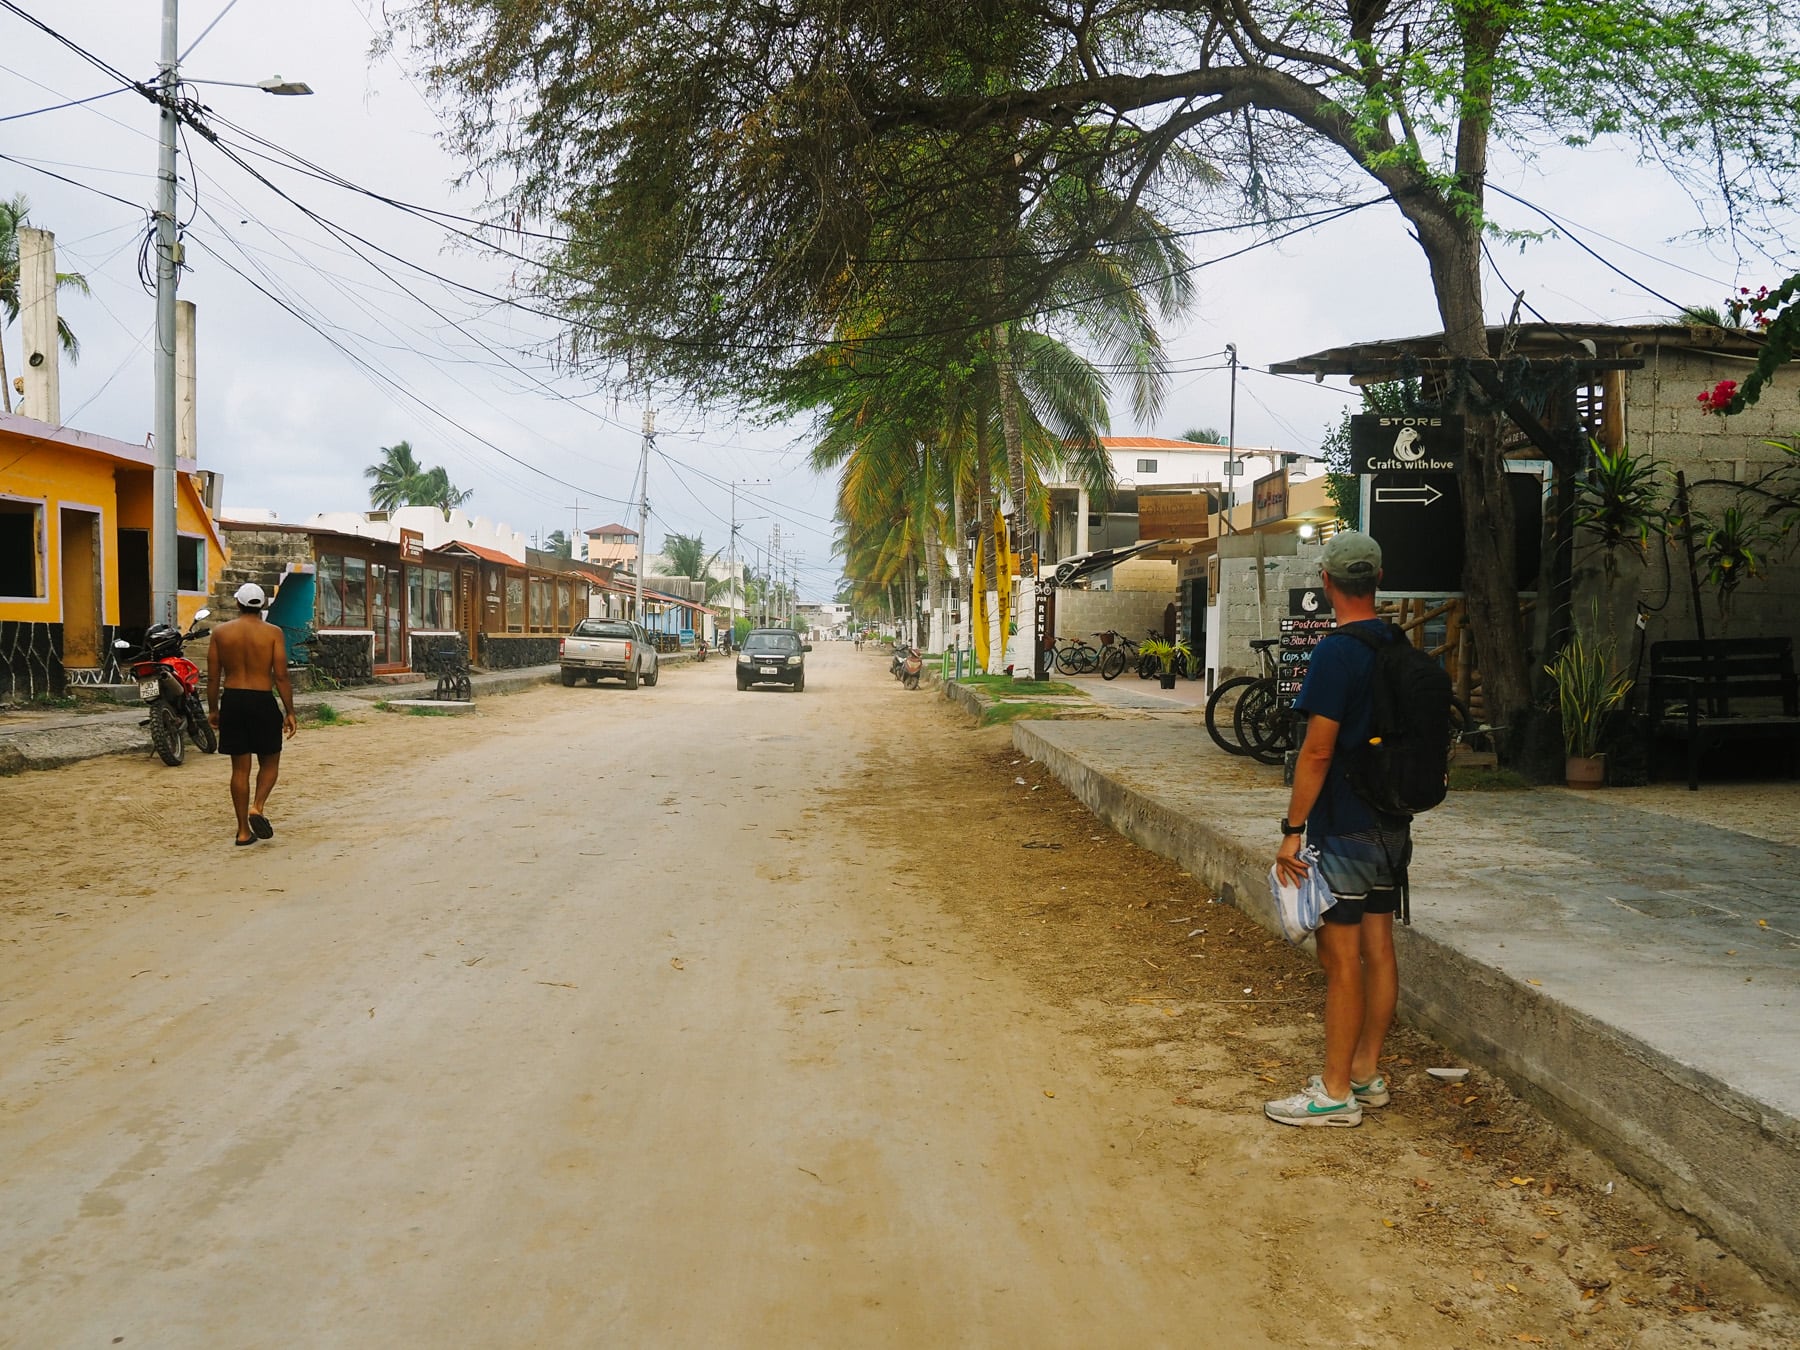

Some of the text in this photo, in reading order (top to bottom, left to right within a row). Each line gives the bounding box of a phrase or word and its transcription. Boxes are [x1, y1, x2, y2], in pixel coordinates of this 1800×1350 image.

[1379, 418, 1442, 427] STORE
[1367, 457, 1454, 470] Crafts with love
